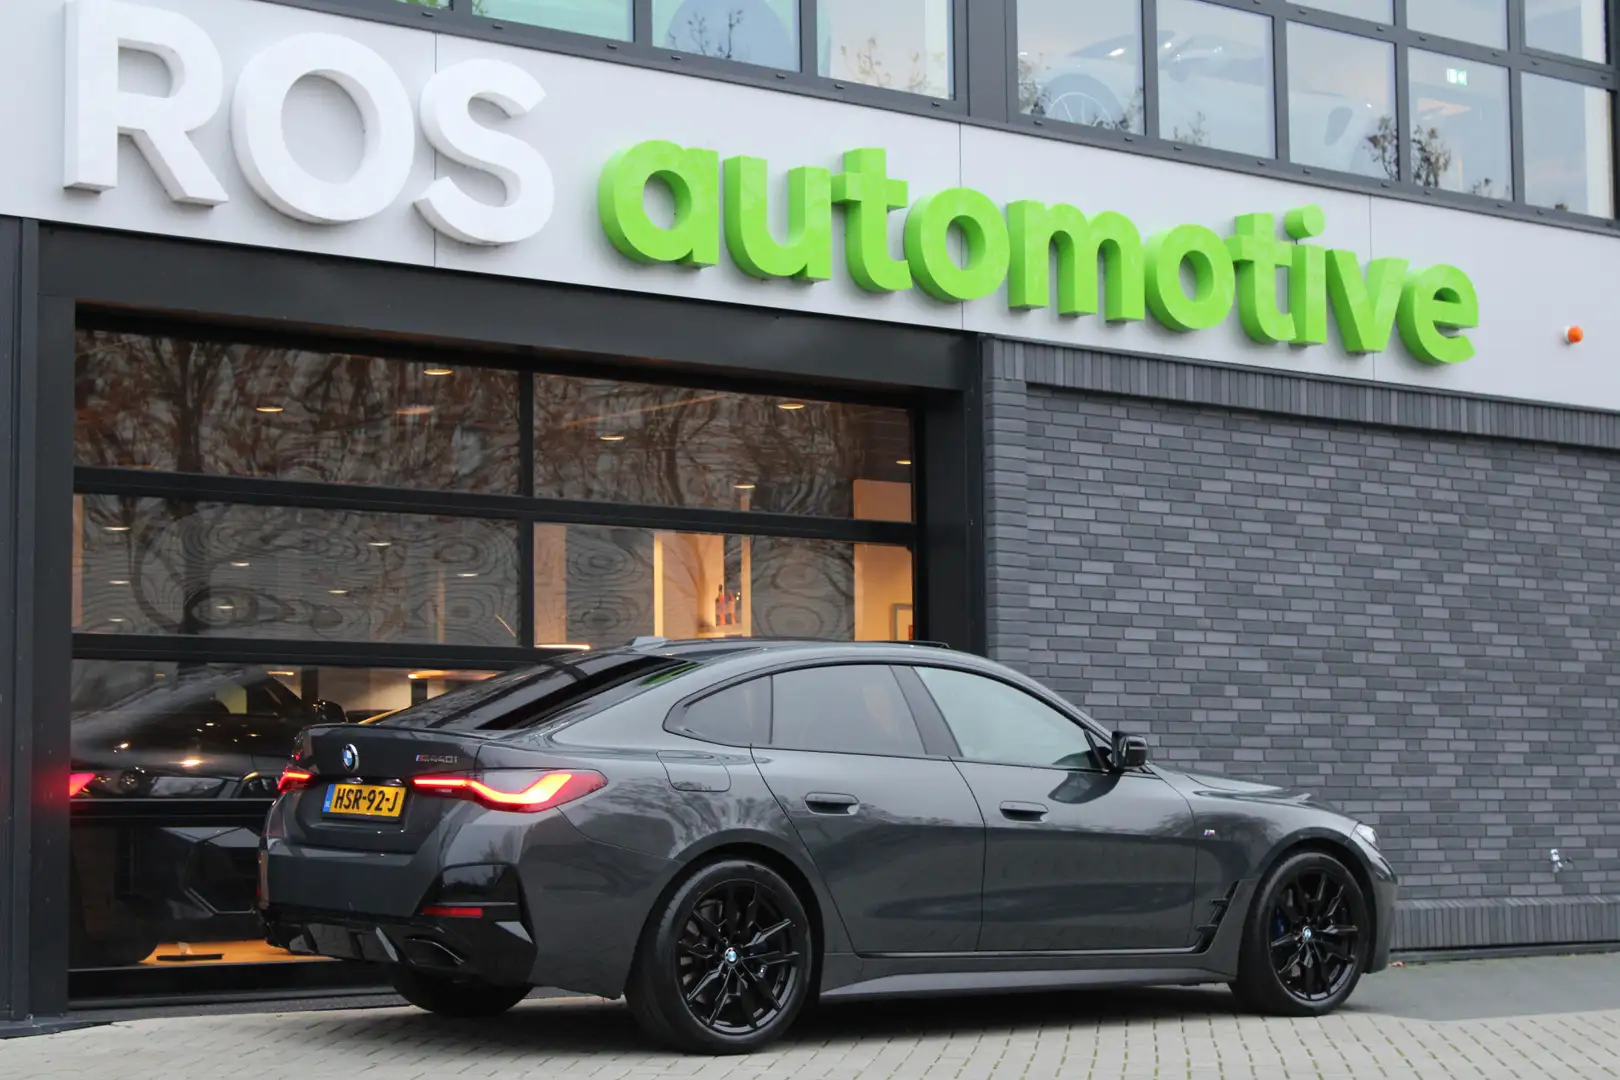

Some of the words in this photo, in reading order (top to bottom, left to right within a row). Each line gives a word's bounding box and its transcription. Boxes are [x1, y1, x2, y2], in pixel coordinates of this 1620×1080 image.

[63, 0, 555, 246] ROS
[598, 139, 1479, 364] automotive
[334, 788, 399, 812] HSR-92-J
